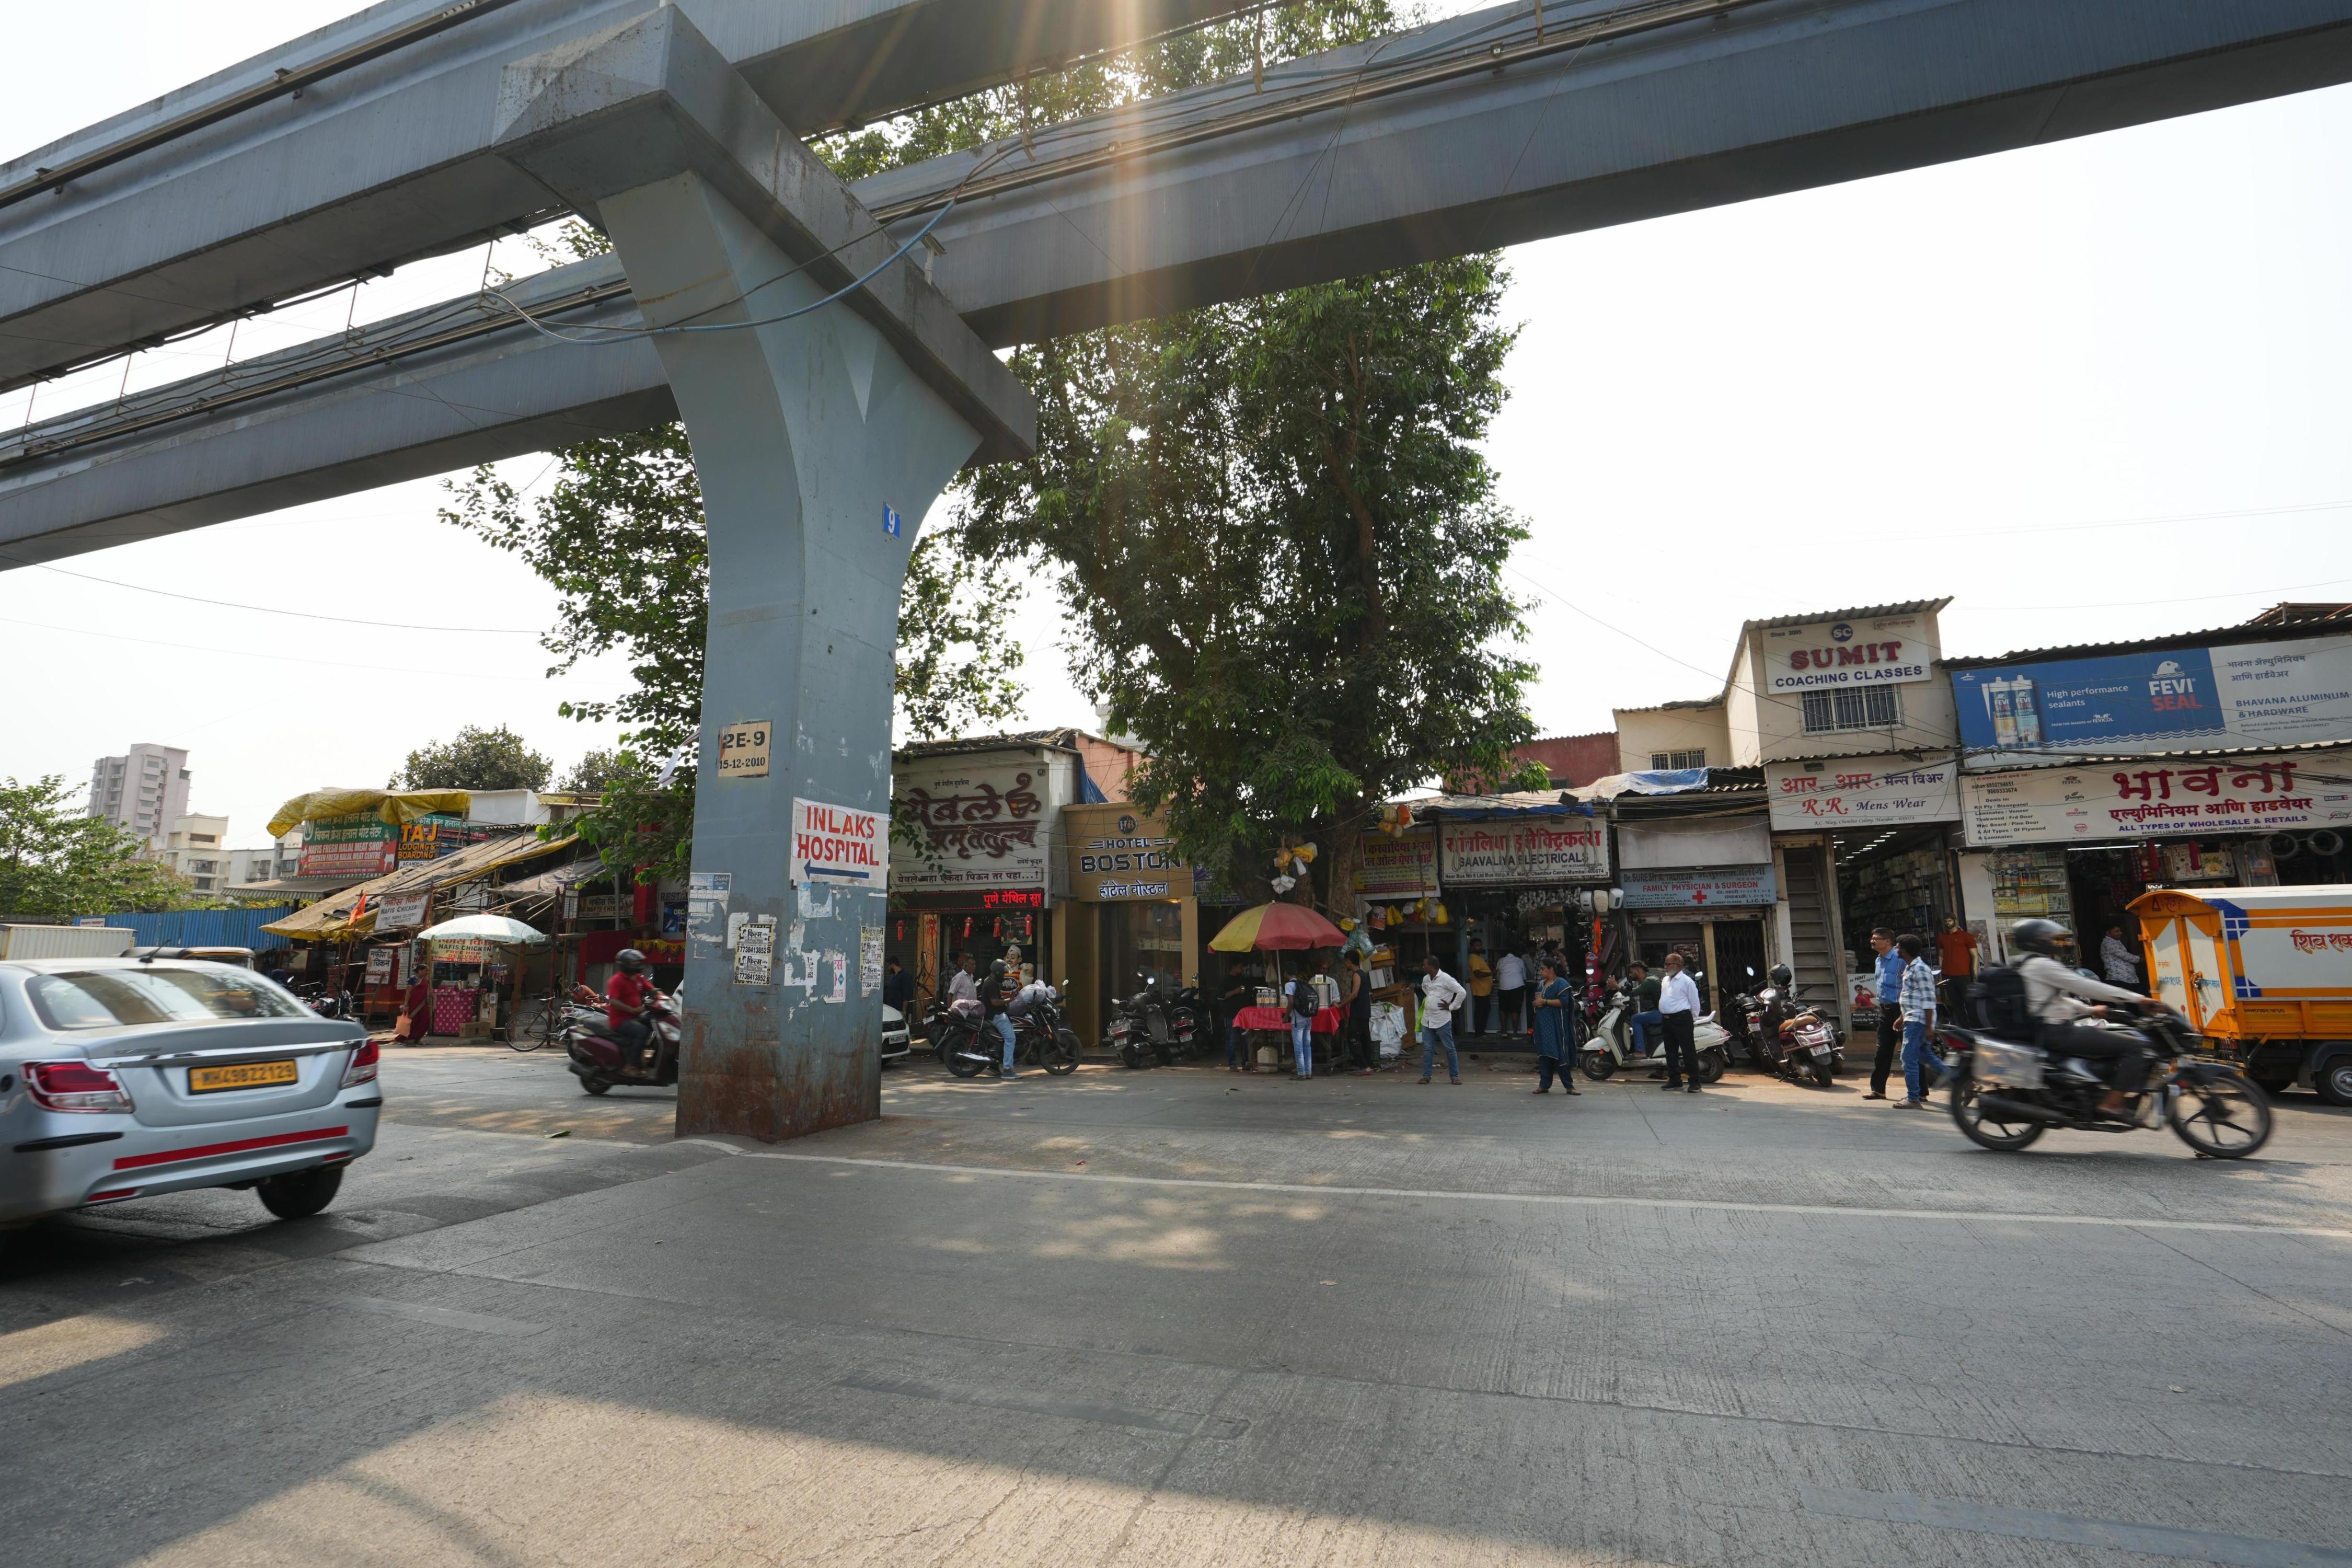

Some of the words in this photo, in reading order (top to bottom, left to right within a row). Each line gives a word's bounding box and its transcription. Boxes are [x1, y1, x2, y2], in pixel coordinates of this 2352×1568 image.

[888, 509, 895, 534] 9
[1833, 628, 1852, 639] SC
[1790, 641, 1902, 670] SUMIT
[2227, 659, 2252, 667] भावना
[1775, 672, 1848, 687] COACHING
[1854, 665, 1922, 681] CLASSES
[2231, 672, 2253, 681] आणि
[2047, 689, 2068, 699] High
[2070, 685, 2129, 697] performance
[2148, 678, 2195, 696] FEVI
[2048, 698, 2085, 709] sealants
[2152, 694, 2204, 712] SEAL
[2236, 697, 2287, 707] BHAVANA
[2289, 691, 2350, 703] ALUMINUM
[2248, 706, 2309, 718] HARDWARE
[719, 757, 765, 769] 15-12-2010
[1780, 777, 1824, 793] आर.
[1835, 773, 1880, 790] आर.
[1912, 771, 1944, 785] विअर
[2113, 760, 2297, 801] भावना
[1802, 797, 1849, 816] R.R.
[1857, 801, 1888, 811] Mens
[1893, 798, 1926, 809] Wear
[2205, 799, 2246, 815] आणि
[806, 805, 875, 839] INLAKS
[2119, 823, 2136, 832] ALL
[2140, 822, 2170, 831] TYPES
[2190, 818, 2250, 828] WHOLESALE
[2264, 815, 2308, 824] RETAILS
[314, 827, 330, 841] चिकन
[342, 827, 358, 841] हलाल
[359, 824, 369, 838] मीट
[370, 823, 382, 837] सेंटर
[401, 823, 439, 842] TAJ
[308, 845, 322, 855] NAFIS
[323, 844, 338, 854] FRESH
[339, 843, 354, 852] HALAL
[354, 842, 368, 851] MEAT
[369, 841, 383, 851] SHOP
[797, 833, 880, 866] HOSPITAL
[1106, 837, 1151, 850] HOTEL
[308, 854, 326, 862] CHICKEN
[327, 853, 339, 861] FRESH
[1080, 851, 1182, 873] BOSTON
[1459, 855, 1516, 868] SAAVALIYA
[1517, 852, 1589, 864] ELECTRICALS
[897, 873, 918, 883] येवले
[940, 874, 963, 884] एकदा
[966, 871, 989, 881] पिऊन
[1098, 879, 1130, 899] हॉटेल
[1130, 879, 1168, 896] बोस्टन
[384, 897, 404, 907] नफीस
[406, 895, 423, 904] चिकन
[983, 894, 999, 908] पुणे
[1001, 890, 1027, 904] येथिल
[747, 929, 763, 939] फिल्म
[2290, 929, 2328, 954] शिव
[371, 949, 387, 958] नफीस
[740, 946, 767, 954] 7738413852
[373, 958, 391, 967] चिकन
[747, 955, 762, 965] फिल्म
[739, 972, 766, 982] 7738413852
